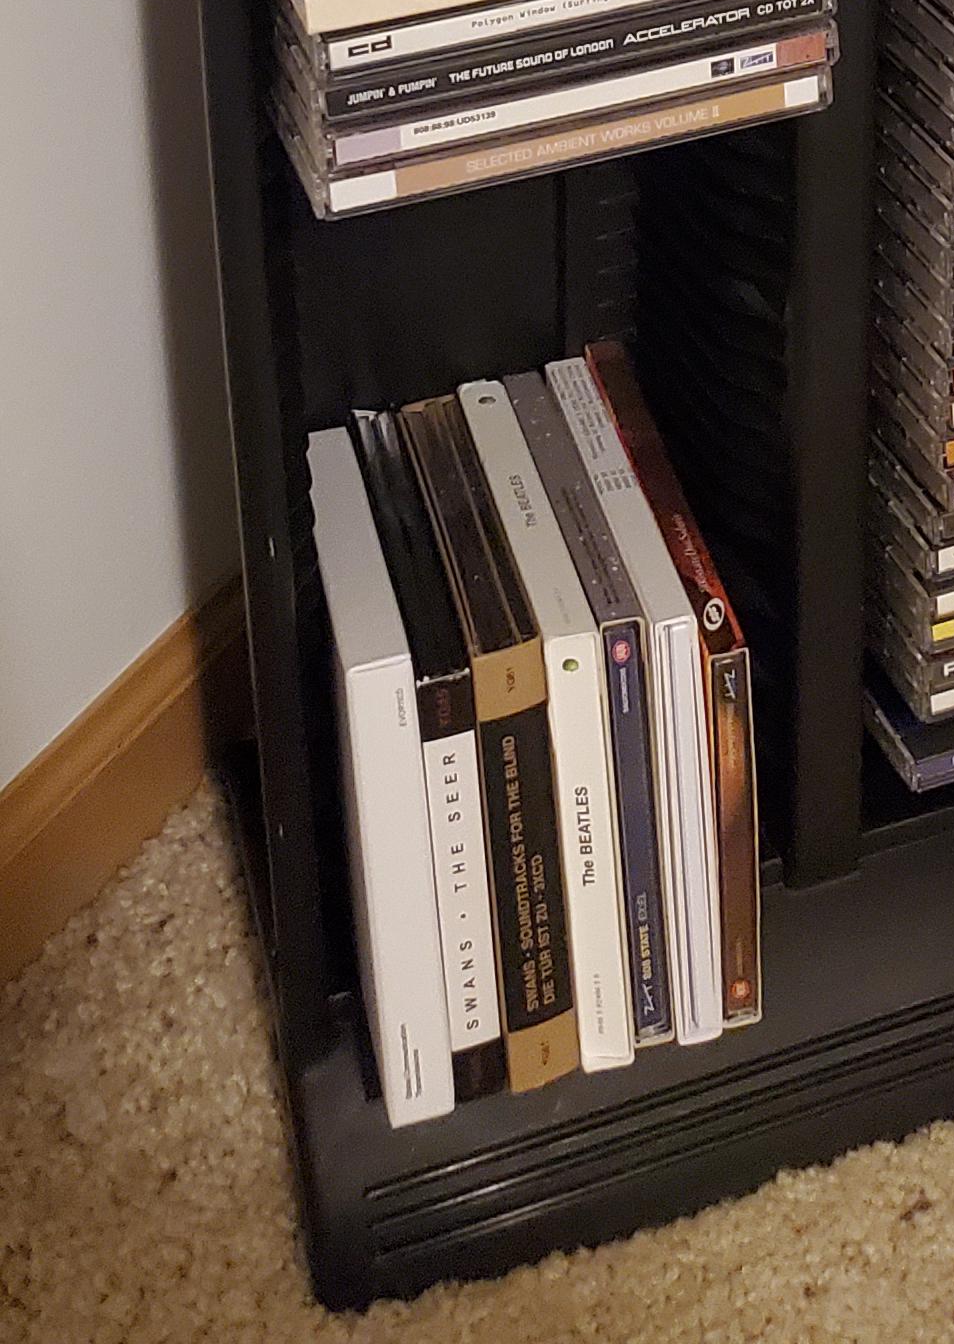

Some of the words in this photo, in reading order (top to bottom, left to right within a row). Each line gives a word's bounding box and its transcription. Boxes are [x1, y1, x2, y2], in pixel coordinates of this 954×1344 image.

[502, 735, 519, 780] BLIND
[443, 752, 462, 823] SEER
[506, 781, 522, 809] THE
[509, 812, 524, 842] FOR
[575, 785, 594, 856] BEATLES
[450, 842, 467, 894] THE
[581, 858, 596, 888] The
[512, 842, 534, 951] SOUNDTRACKS
[460, 939, 480, 1031] SWANS
[524, 960, 540, 1013] SWANS
